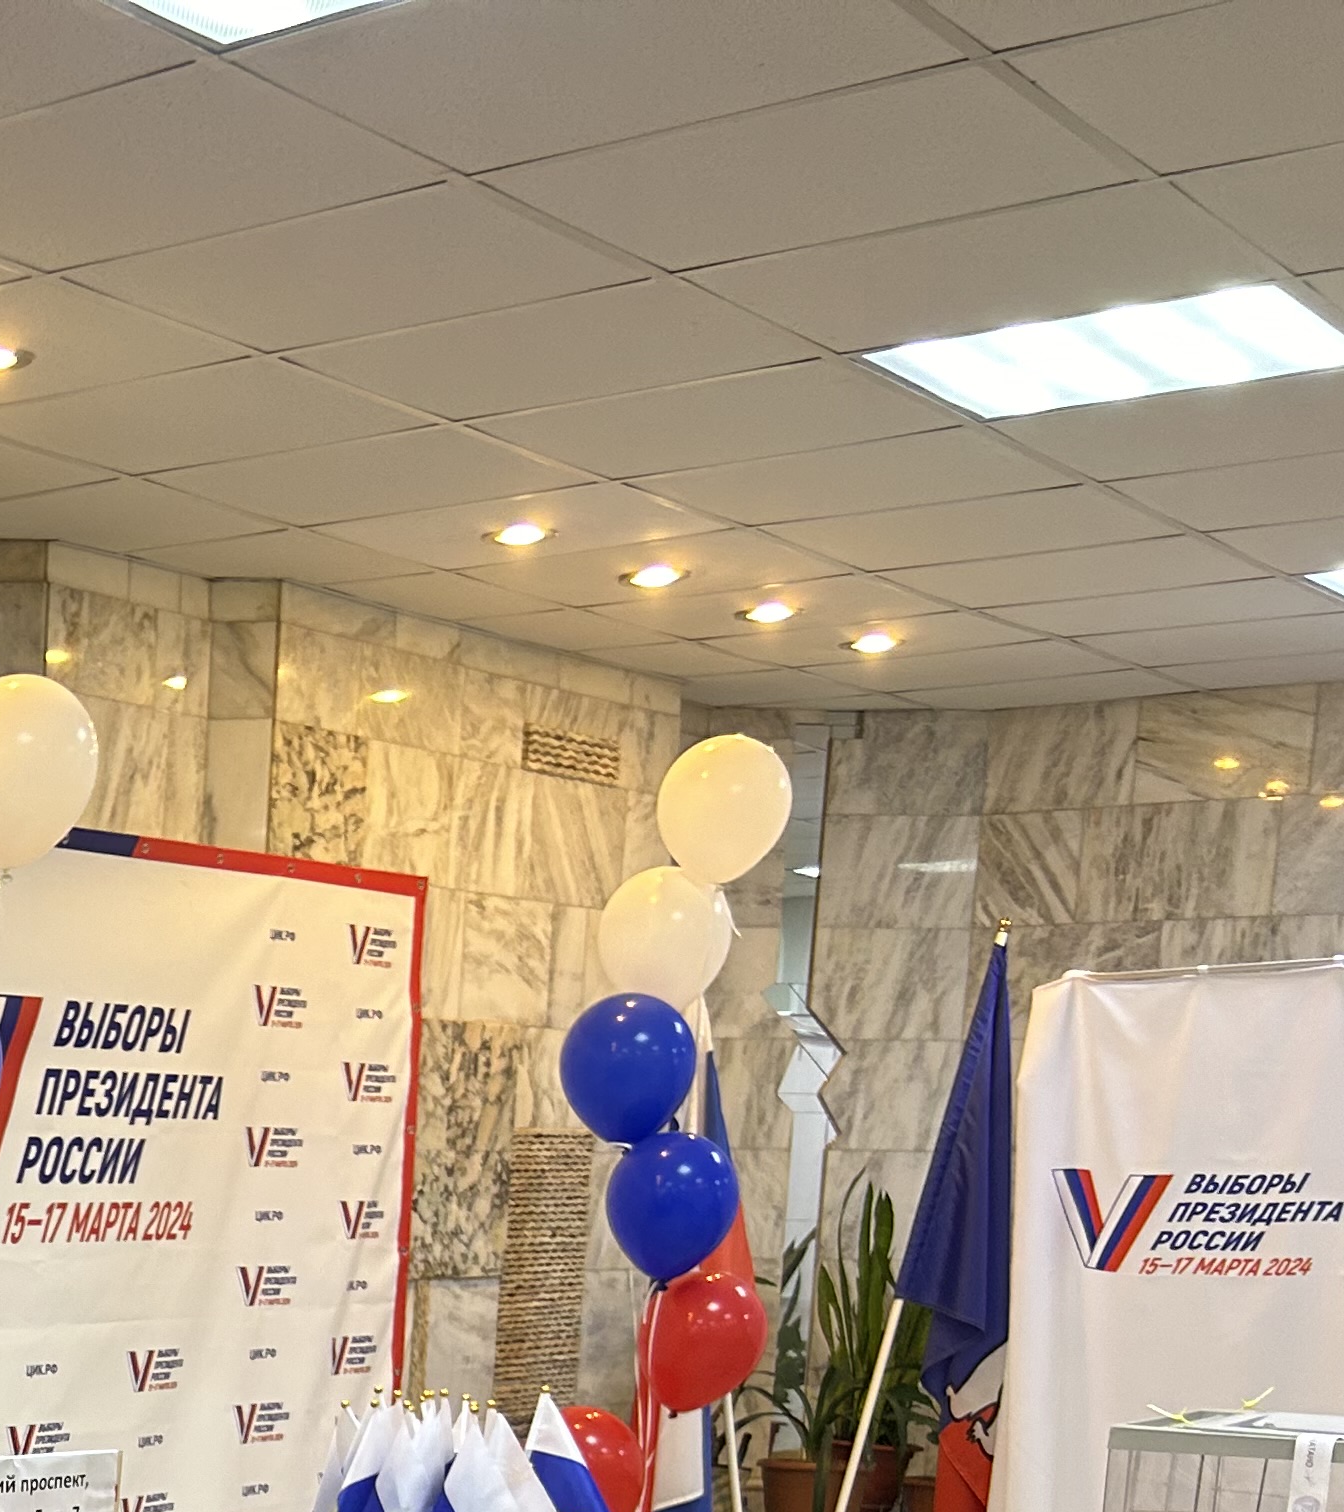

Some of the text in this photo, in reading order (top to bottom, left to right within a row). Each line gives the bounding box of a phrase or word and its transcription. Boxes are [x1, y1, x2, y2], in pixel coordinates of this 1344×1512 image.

[53, 1000, 191, 1054] ВЫБОРЫ
[35, 1068, 224, 1125] ПРЕЗИДЕНТА
[16, 1136, 146, 1184] РОССИИ
[1184, 1173, 1311, 1195] ВЫБОРЫ
[67, 1202, 140, 1244] МАРТА
[142, 1201, 192, 1241] 2024
[1168, 1201, 1344, 1226] ПРЕЗИДЕНТА
[1150, 1230, 1266, 1252] РОССИИ
[1193, 1258, 1262, 1277] МАРТА
[1263, 1257, 1313, 1277] 2024
[20, 1472, 89, 1497] проспект,
